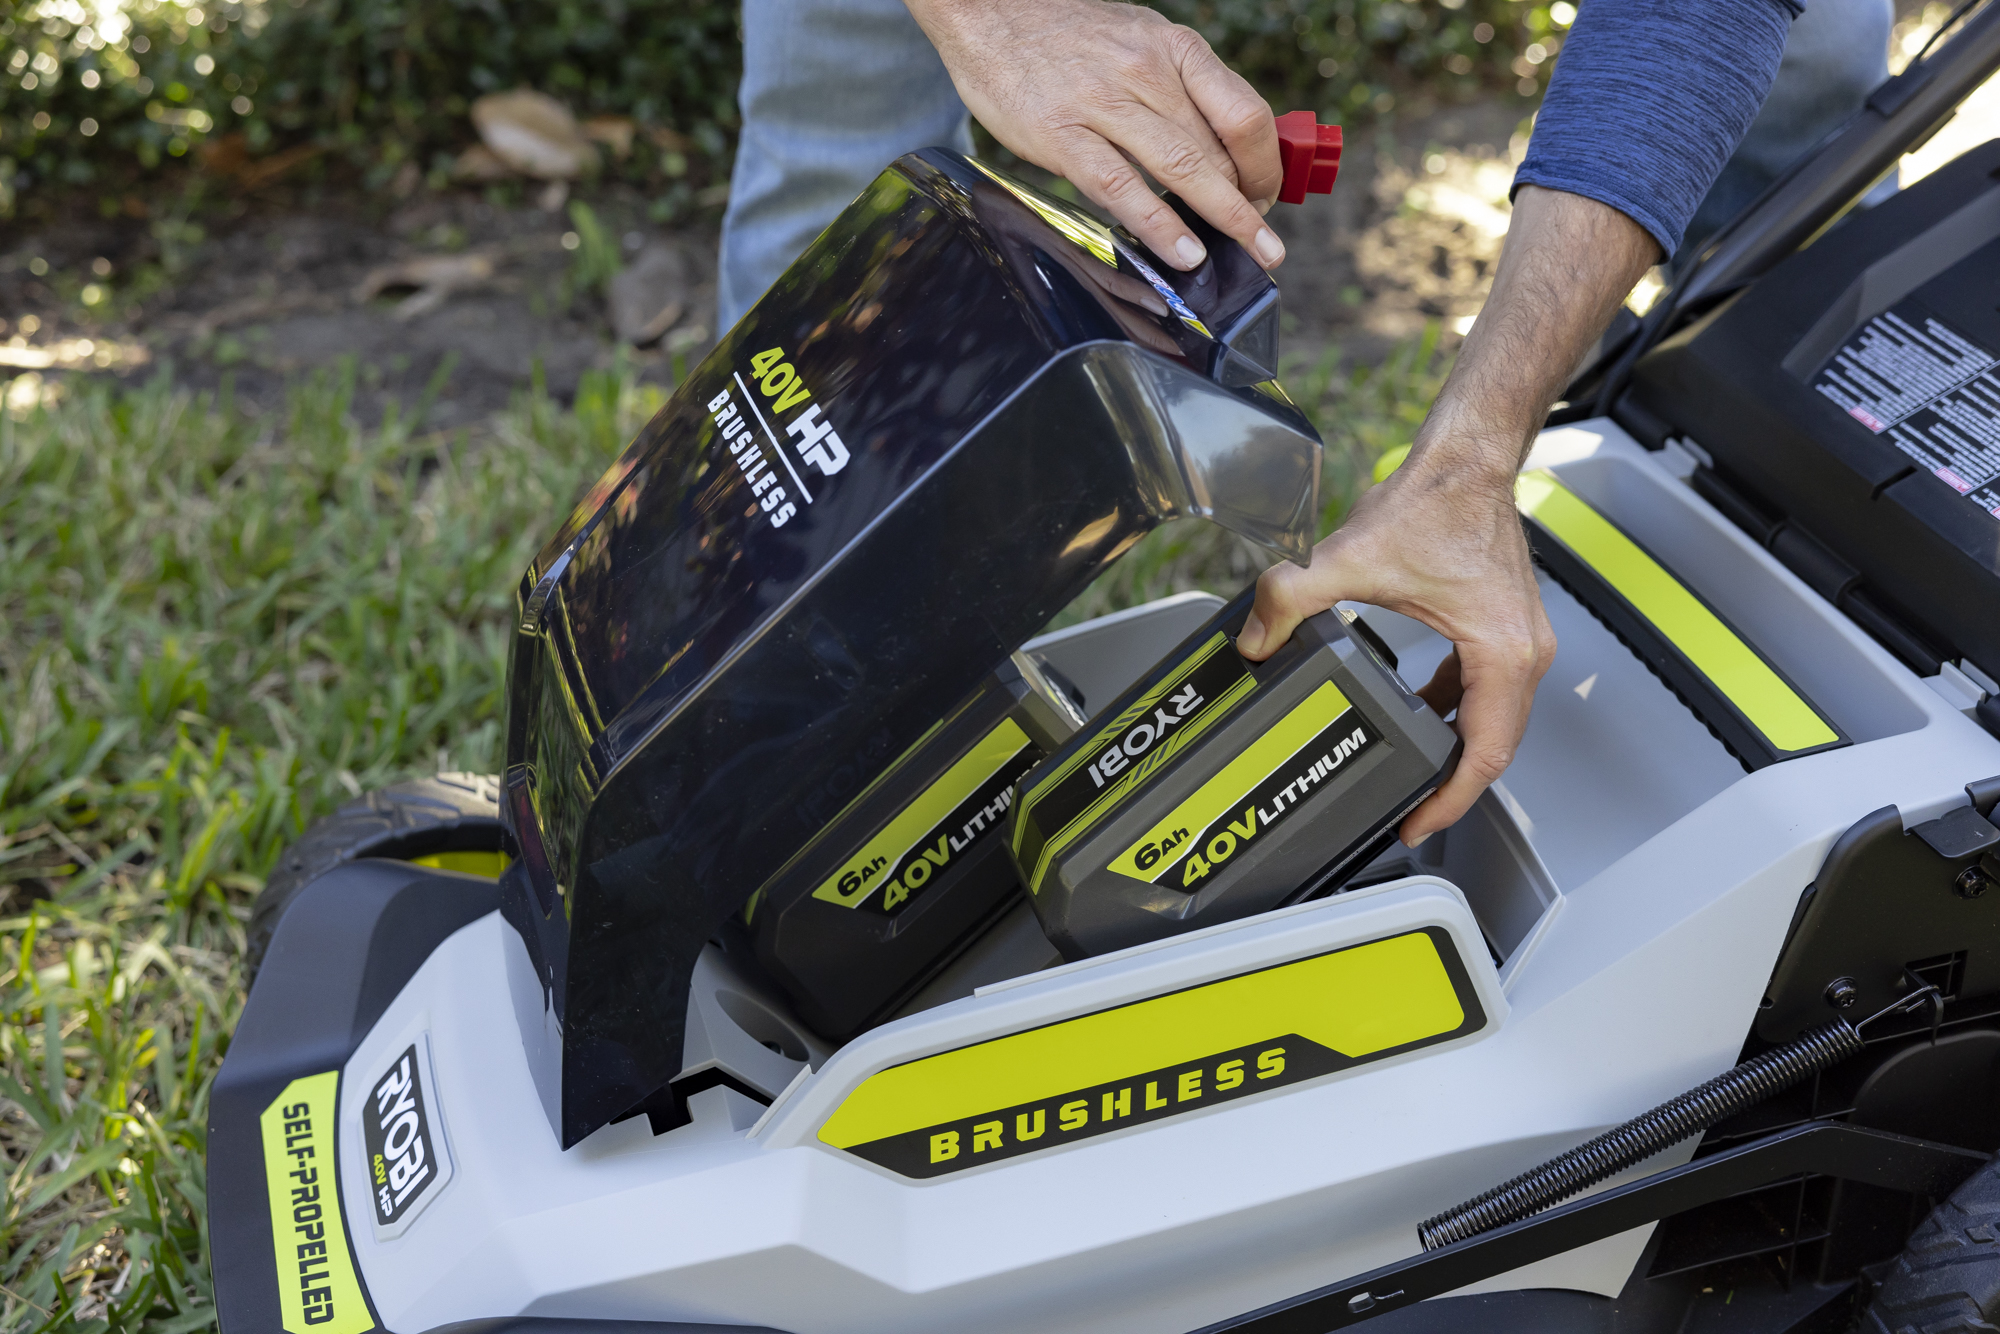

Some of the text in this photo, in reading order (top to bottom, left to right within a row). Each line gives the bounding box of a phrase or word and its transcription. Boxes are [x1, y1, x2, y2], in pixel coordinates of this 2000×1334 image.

[707, 388, 797, 529] BRUSHLESS
[750, 346, 851, 476] 40V HP
[1087, 683, 1205, 789] RYOBI
[837, 855, 888, 897] 6Ah
[1134, 826, 1190, 871] 6Ah
[376, 1055, 429, 1208] RYOBI
[929, 1047, 1286, 1164] BRUSHLESS
[282, 1102, 335, 1326] SELF-PROPELLED
[373, 1154, 394, 1217] 40V HP
